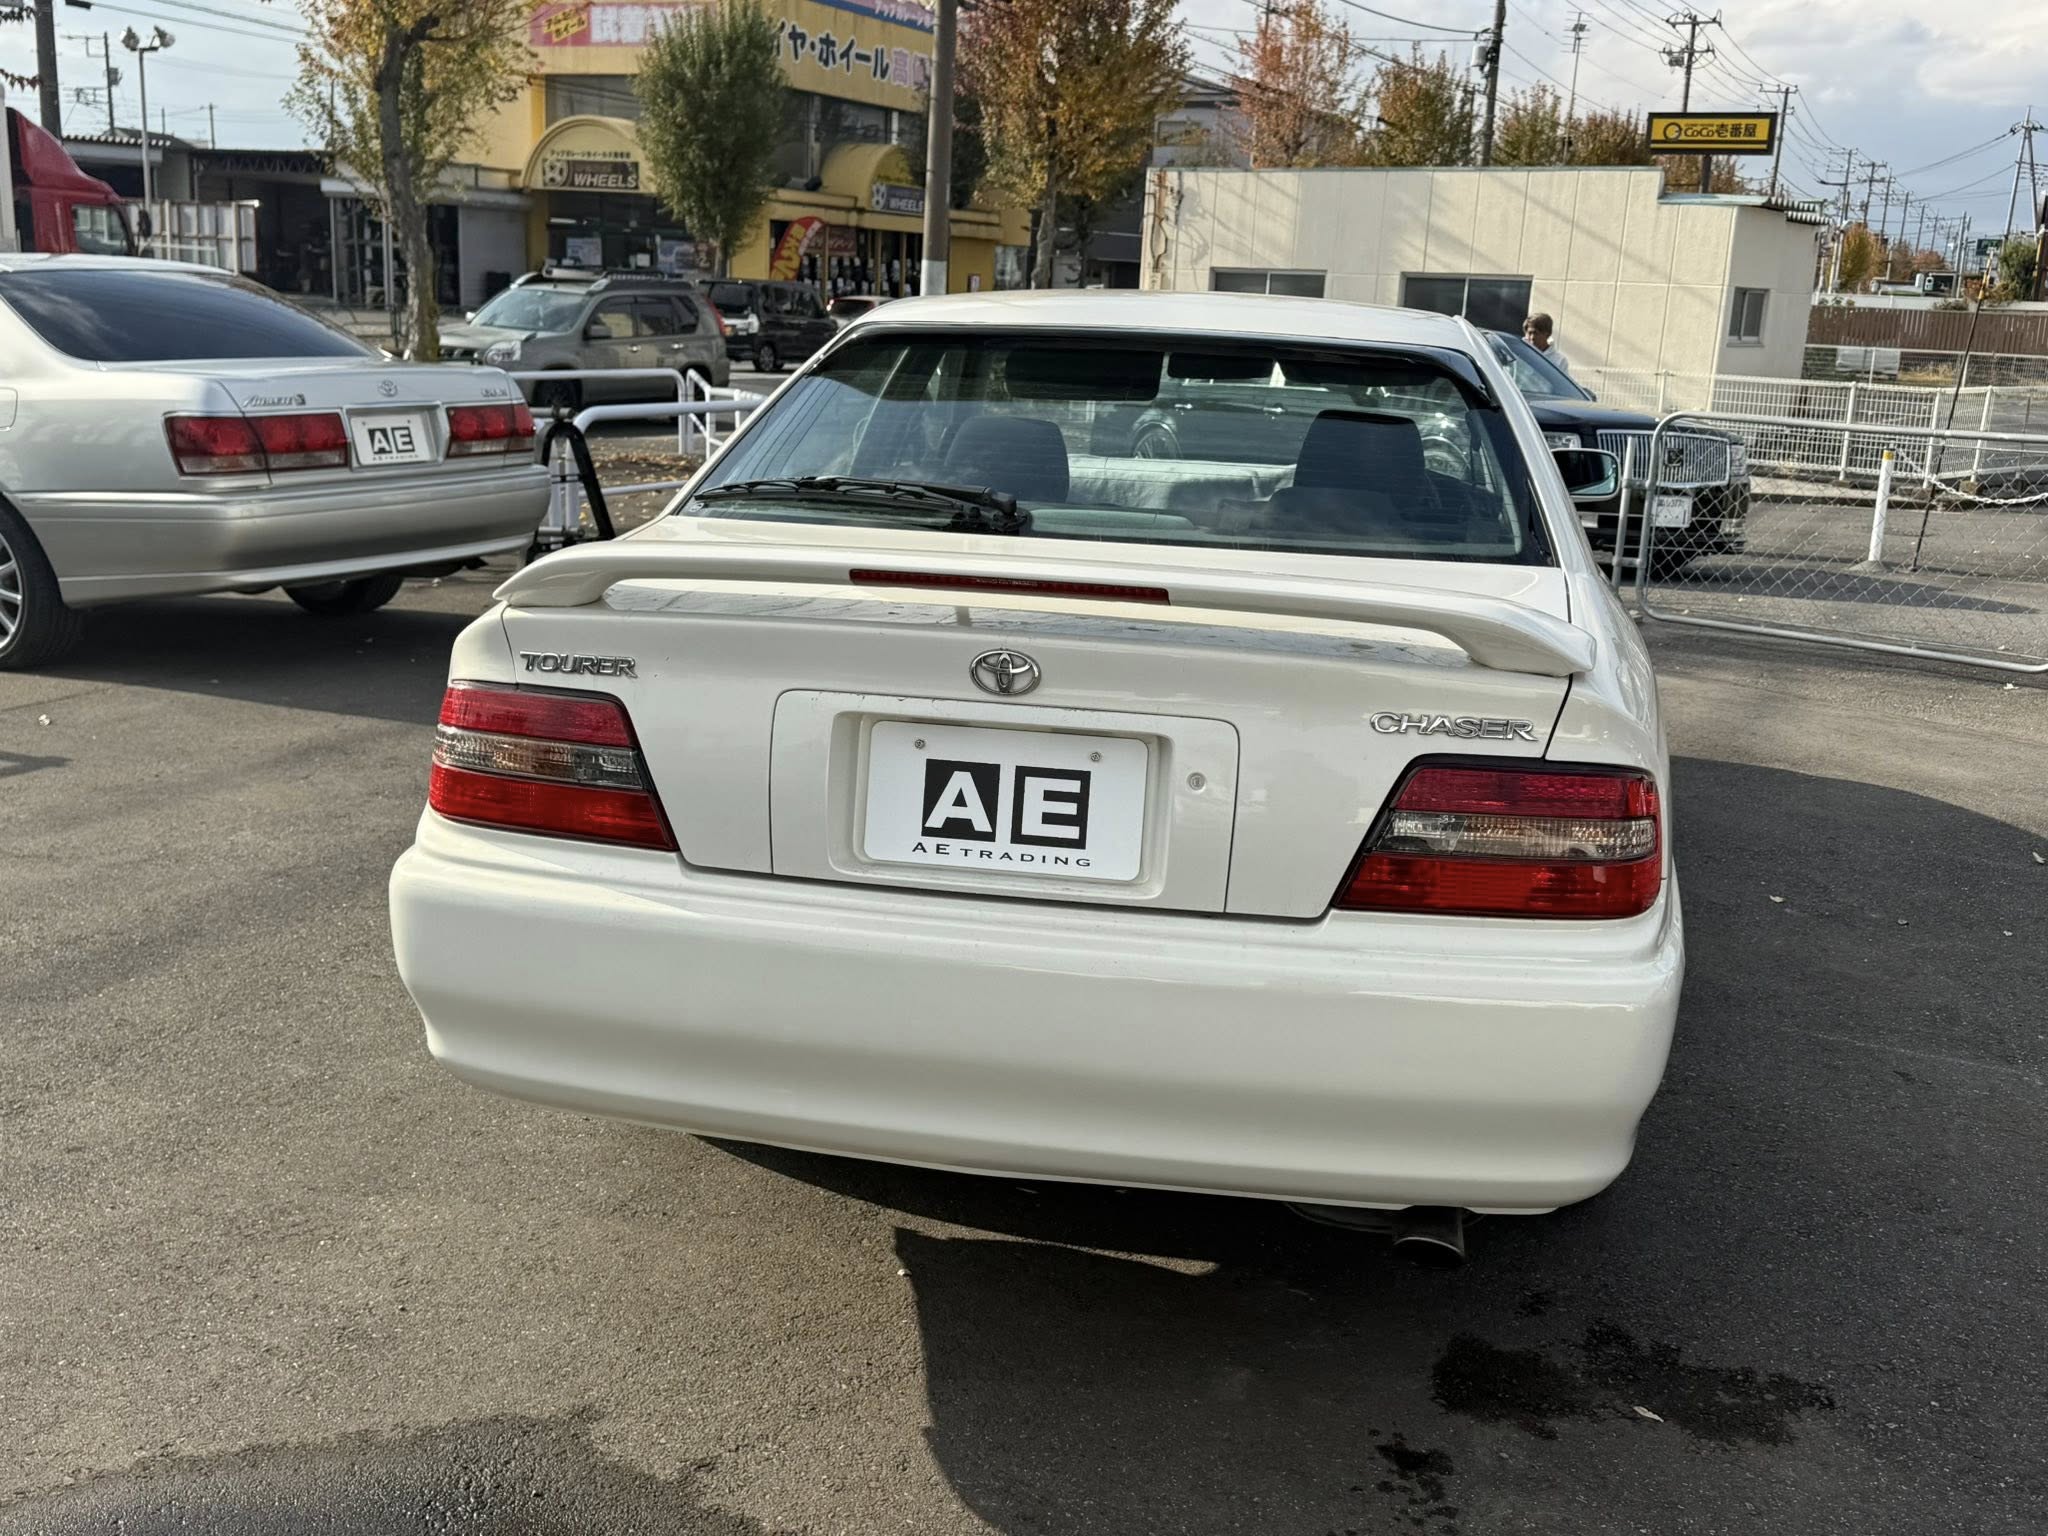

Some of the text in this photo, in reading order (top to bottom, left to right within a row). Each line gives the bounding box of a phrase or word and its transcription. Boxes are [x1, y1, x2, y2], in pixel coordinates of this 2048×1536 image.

[574, 173, 638, 188] WHEELS
[372, 429, 413, 452] AE
[519, 650, 638, 679] TOURER
[1370, 712, 1538, 742] CHASER
[923, 769, 1083, 842] AE
